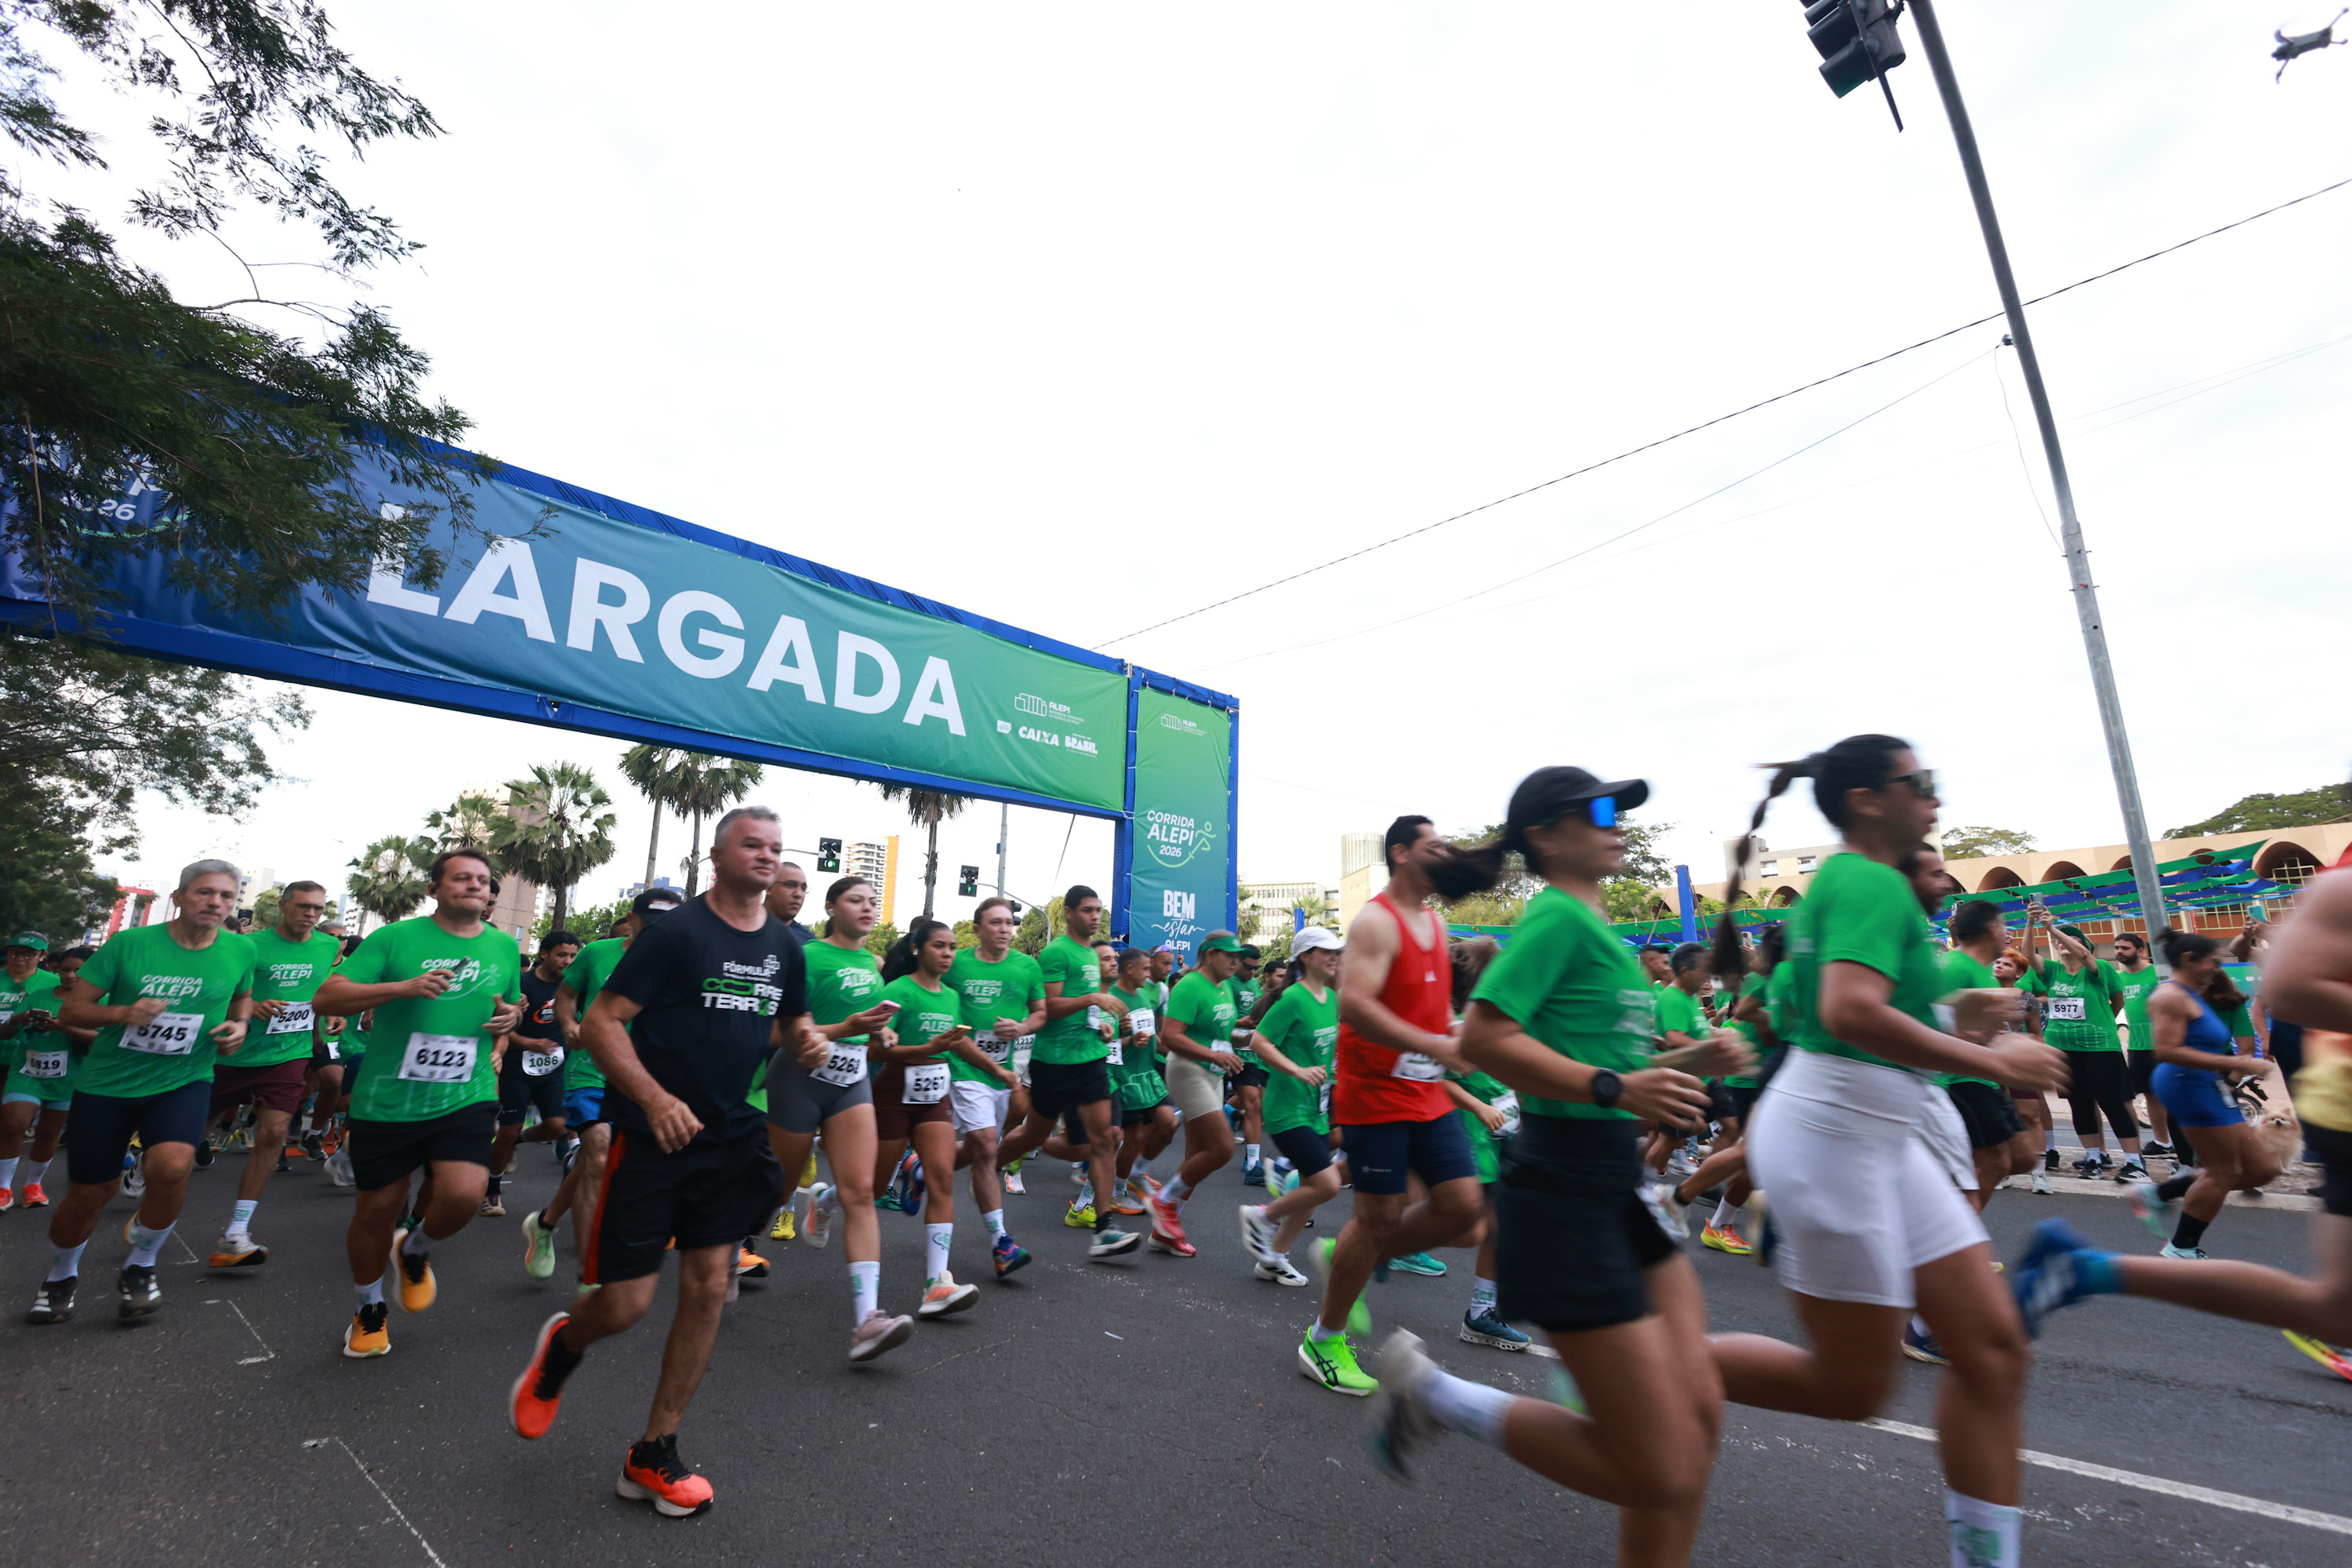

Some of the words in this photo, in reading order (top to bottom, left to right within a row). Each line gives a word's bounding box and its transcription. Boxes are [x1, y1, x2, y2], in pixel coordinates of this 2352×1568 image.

[366, 503, 967, 736] LARGADA
[1049, 702, 1070, 713] ALEPI
[1018, 726, 1059, 746] CAIXA
[1065, 735, 1098, 754] BRASIL
[1147, 810, 1195, 829] CORRIDA
[1147, 823, 1194, 846] ALEPI
[1160, 844, 1181, 857] 2026
[1163, 889, 1196, 920] BEM
[1151, 914, 1206, 939] estar
[268, 970, 312, 980] ALEPI
[723, 960, 771, 977] FÓRMULA
[141, 975, 203, 985] CORRIDA
[138, 983, 202, 998] ALEPI
[703, 978, 783, 1000] CORRE
[964, 986, 1002, 996] ALEPI
[278, 1009, 309, 1022] 5200
[1015, 1036, 1034, 1045] 1212
[416, 1048, 466, 1067] 6123
[528, 1056, 558, 1068] 1086
